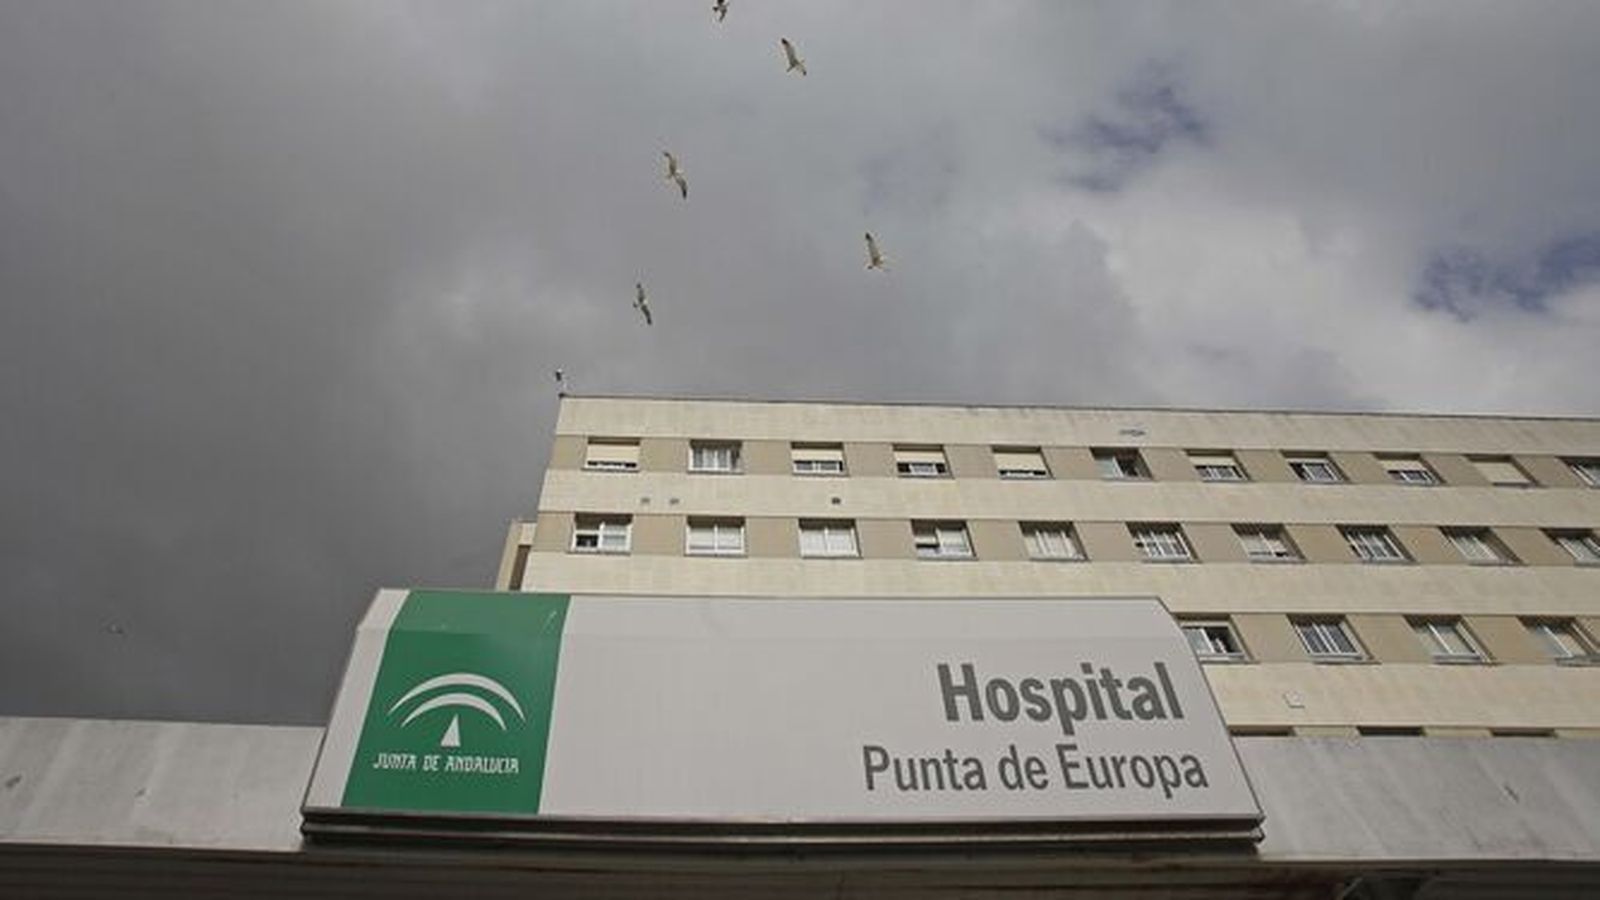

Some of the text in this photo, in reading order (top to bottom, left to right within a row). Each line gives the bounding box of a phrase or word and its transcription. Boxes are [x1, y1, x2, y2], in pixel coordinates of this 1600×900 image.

[937, 662, 1185, 736] Hospital
[373, 752, 417, 771] JUNTA
[423, 754, 440, 772] DE
[863, 743, 1209, 799] Punta de Europa
